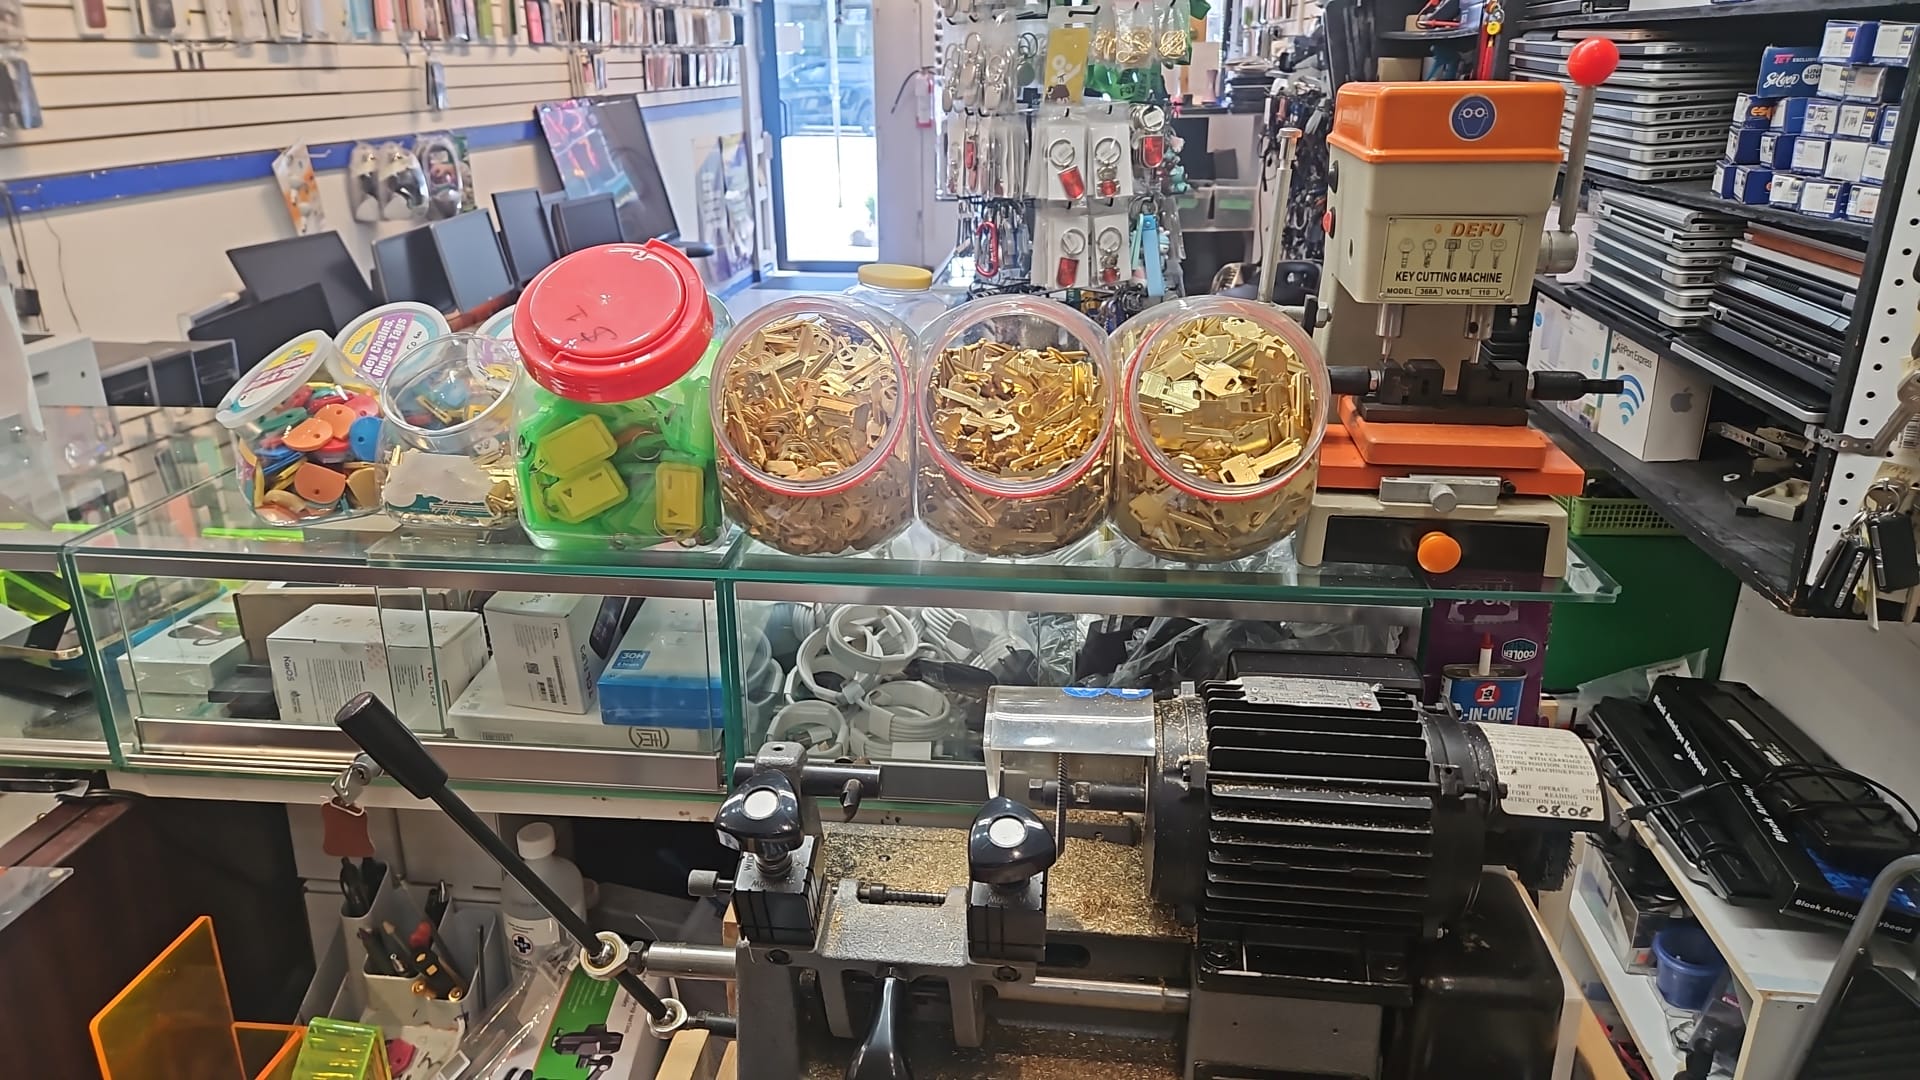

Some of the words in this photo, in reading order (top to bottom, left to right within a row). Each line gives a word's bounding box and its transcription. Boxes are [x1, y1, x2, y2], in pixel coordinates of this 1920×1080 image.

[1451, 222, 1505, 238] DEFU
[1395, 271, 1415, 283] KEY
[1416, 272, 1457, 283] CUTTING
[1458, 272, 1503, 284] MACHINE
[1387, 287, 1413, 295] MODEL
[388, 318, 407, 340] Tags
[362, 353, 378, 372] Key
[370, 320, 395, 353] Chains,
[387, 341, 397, 350] &
[371, 348, 393, 376] Rings
[1616, 343, 1634, 359] AirPort
[1634, 348, 1652, 368] Express
[1503, 650, 1535, 660] COOLER
[1538, 785, 1569, 793] OPERATE
[1545, 792, 1578, 800] READING
[743, 853, 755, 872] WID
[1823, 905, 1858, 921] Antelop
[1877, 920, 1913, 935] yboard
